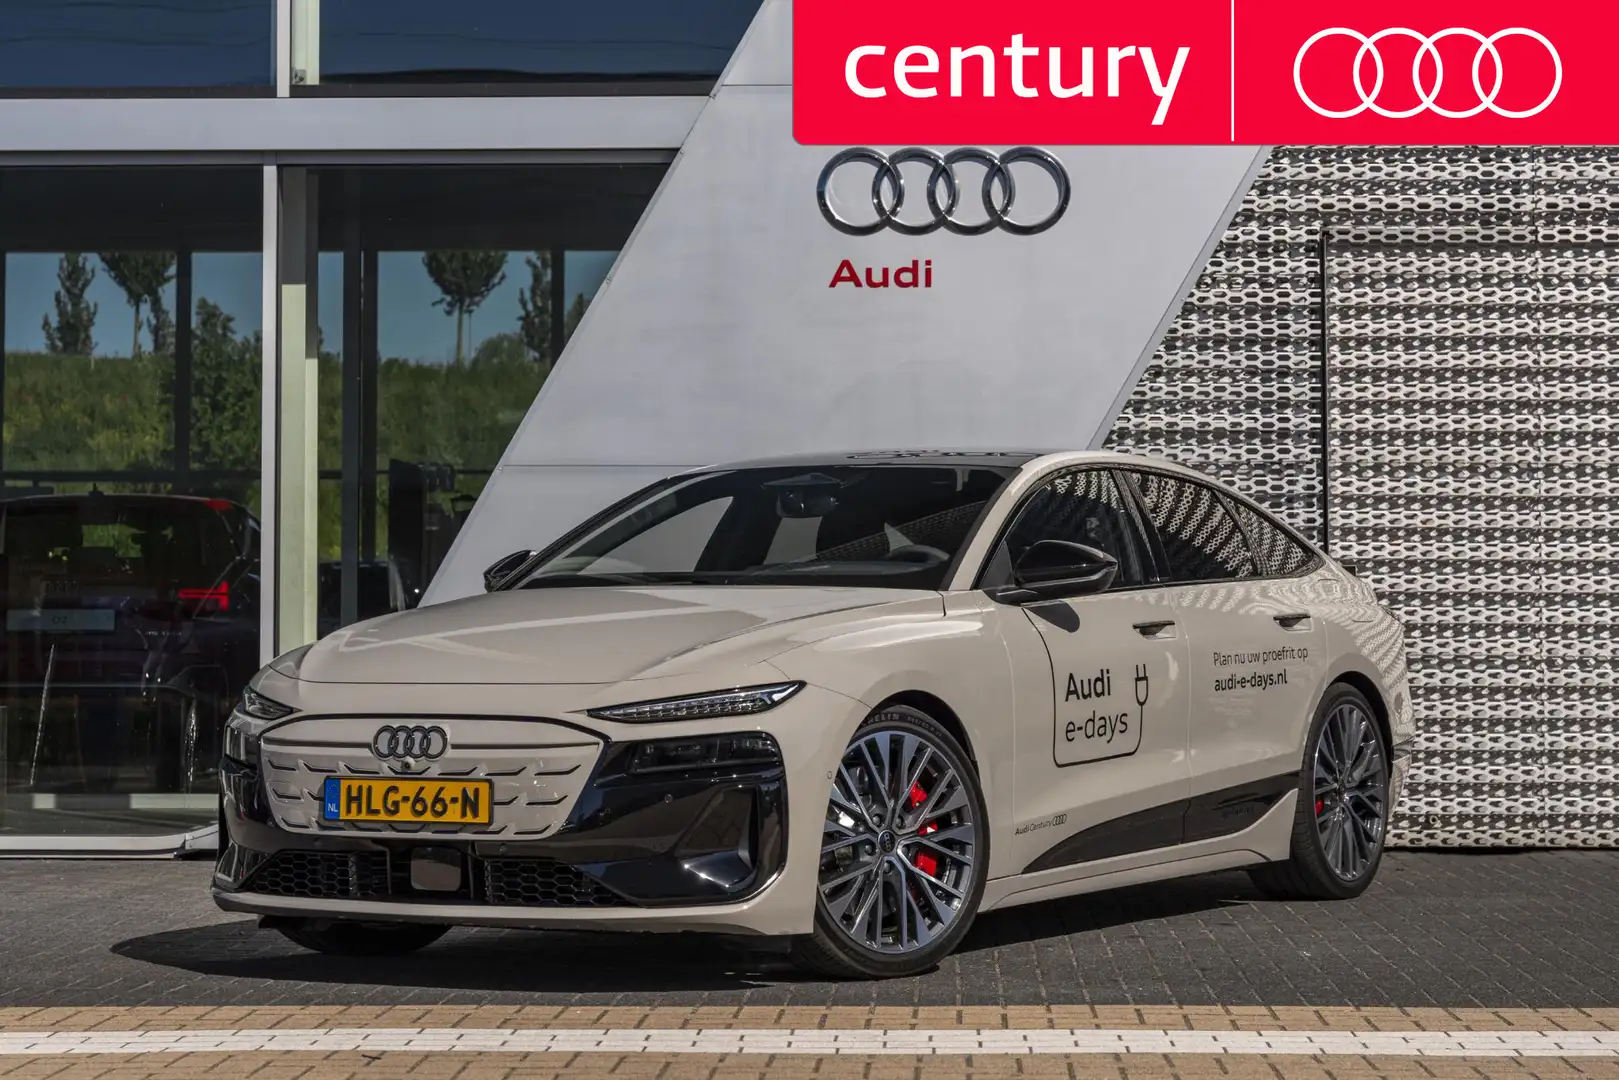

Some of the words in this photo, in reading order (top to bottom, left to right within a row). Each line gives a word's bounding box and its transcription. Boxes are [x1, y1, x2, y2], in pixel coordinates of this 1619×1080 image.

[828, 259, 933, 288] Audi
[1213, 652, 1233, 666] Plan
[1234, 653, 1246, 665] nu
[1247, 652, 1261, 663] uw
[1262, 646, 1296, 665] proefrit
[1297, 647, 1309, 662] op
[1065, 668, 1112, 702] Audi
[1214, 668, 1288, 692] audi-e-days.nl
[1065, 710, 1128, 744] e-days
[327, 803, 339, 813] NL
[346, 784, 480, 819] HLG-66-N
[1015, 824, 1030, 835] Audi
